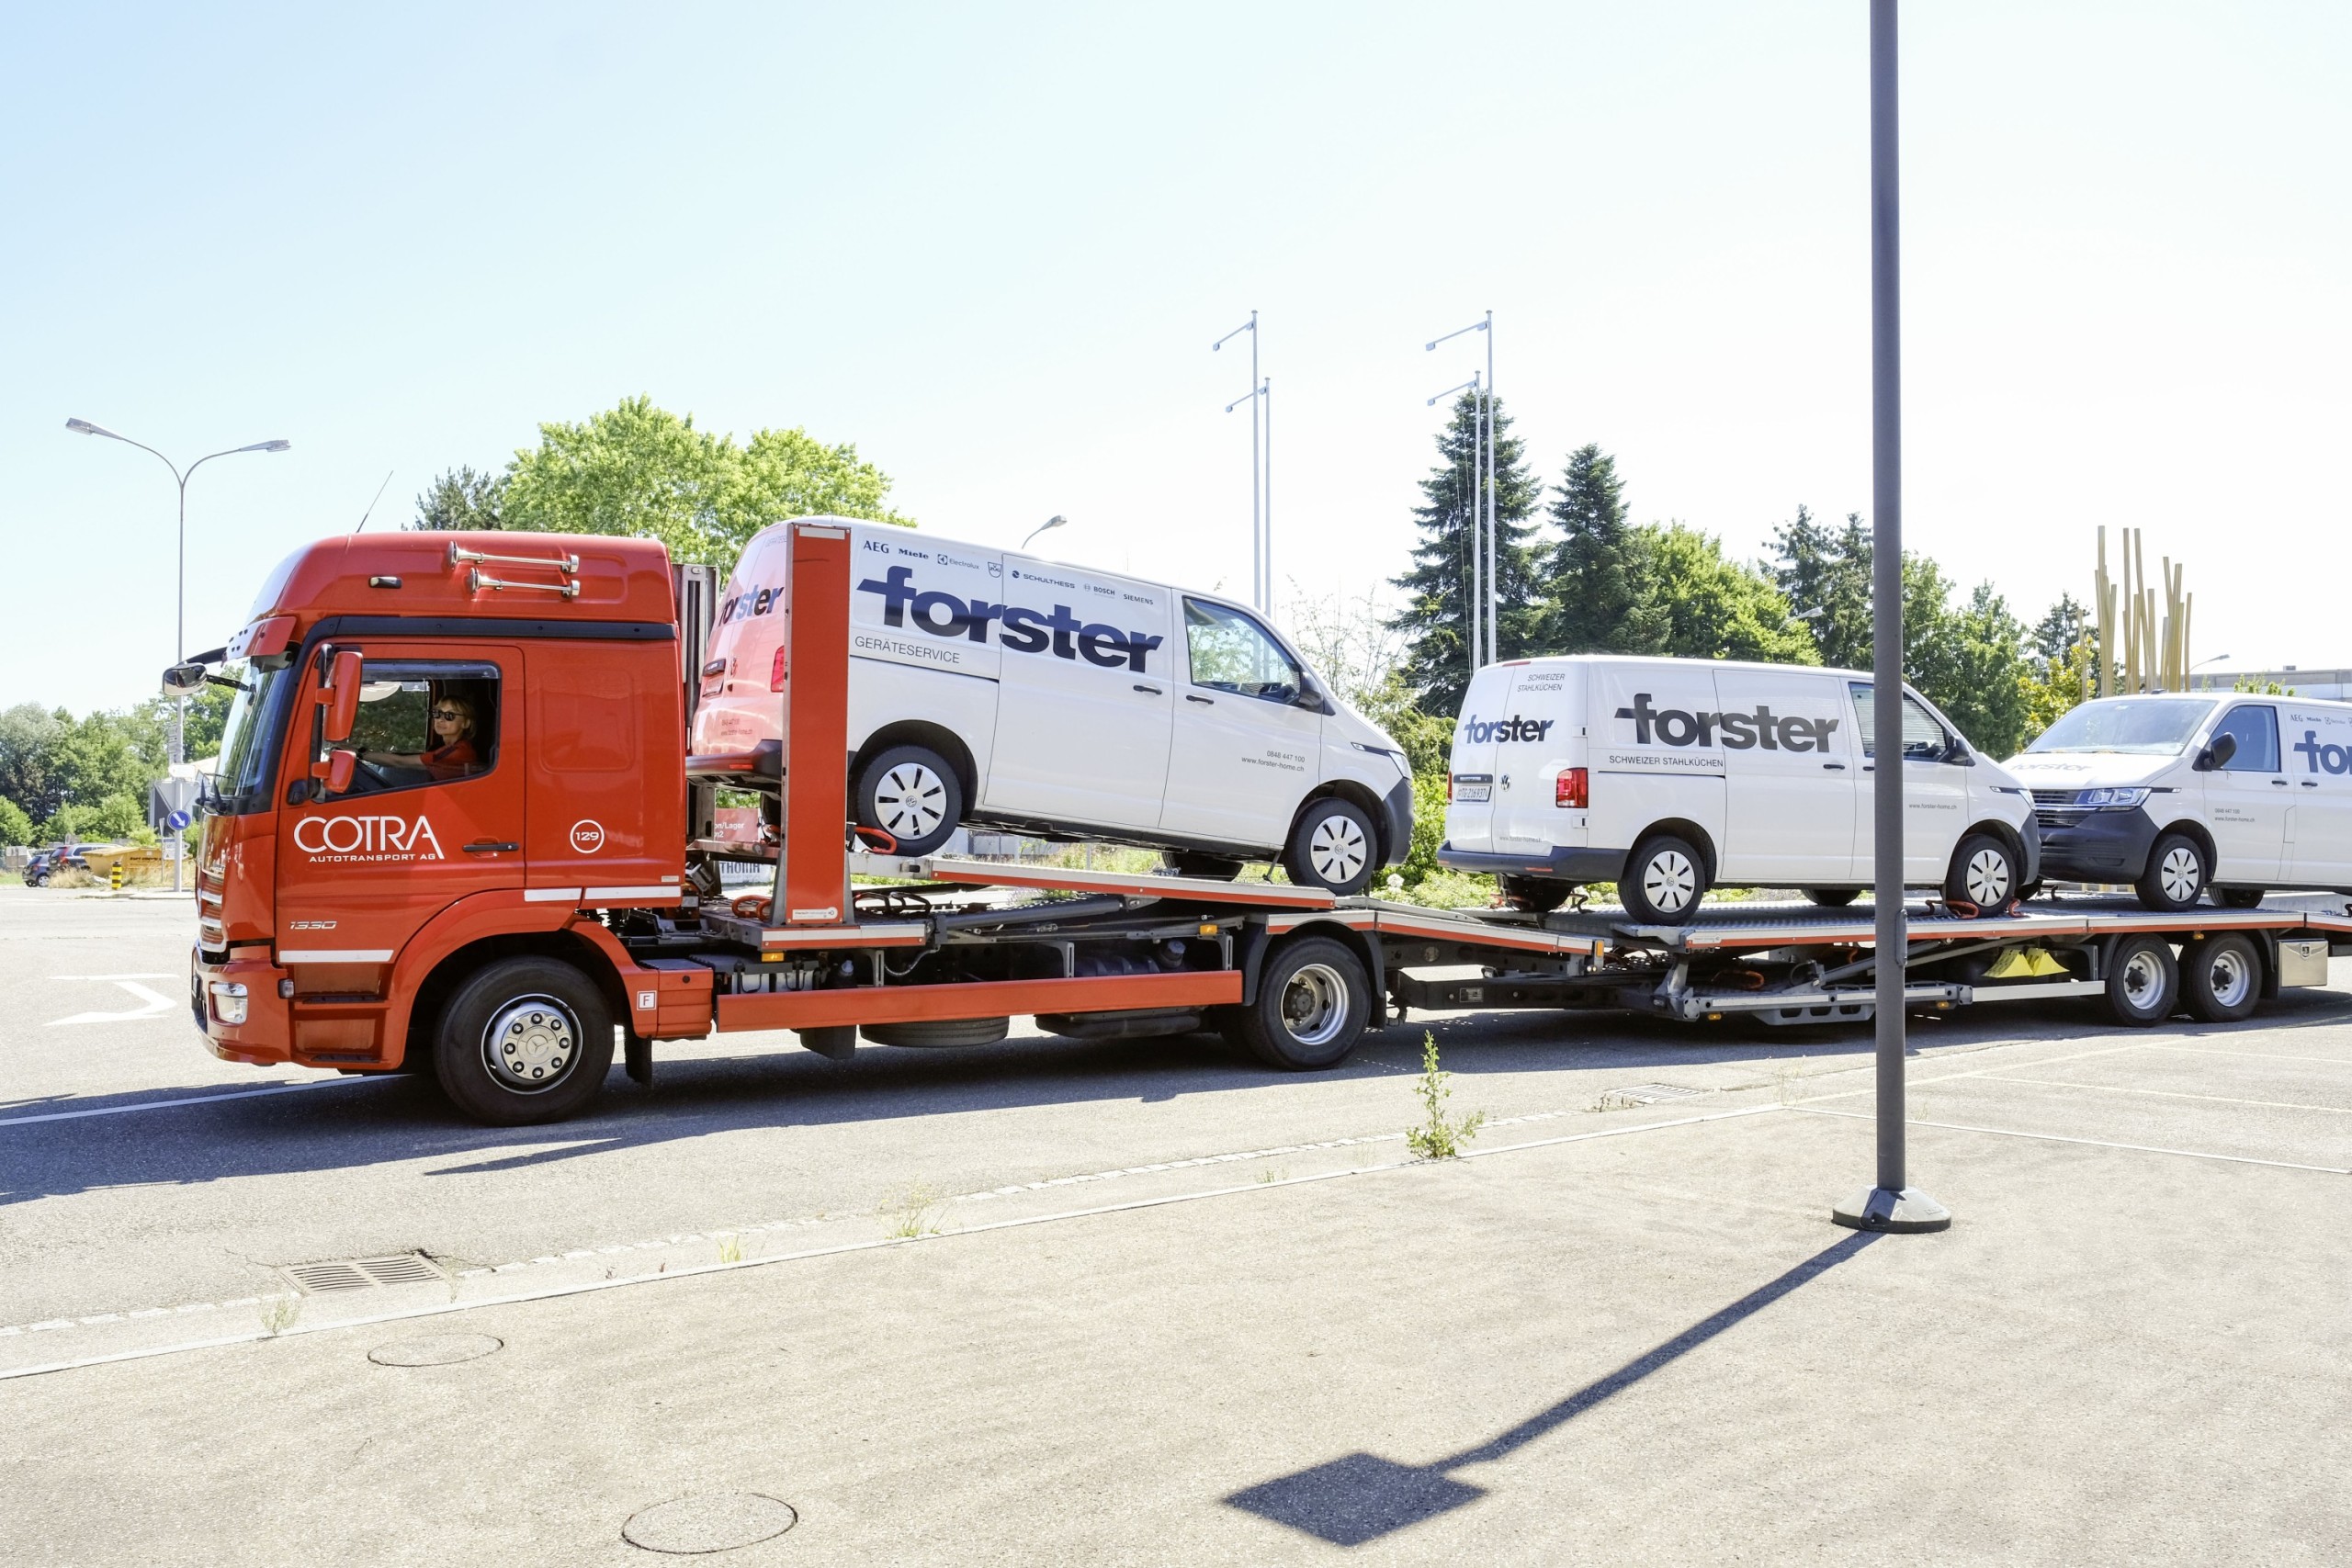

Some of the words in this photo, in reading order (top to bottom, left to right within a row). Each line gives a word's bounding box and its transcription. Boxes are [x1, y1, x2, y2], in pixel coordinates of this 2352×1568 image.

[863, 540, 889, 554] AEG
[899, 547, 929, 559] Miele
[949, 558, 979, 570] Electrolux
[1023, 573, 1075, 589] SCHULTHESS
[1093, 586, 1115, 595] BOSCH
[1123, 593, 1154, 605] SIEMENS
[856, 565, 1164, 673] forster
[854, 636, 960, 663] GERÄTESERVICE
[1527, 673, 1566, 682] SCHWEIZER
[1517, 682, 1563, 692] STAHLKÜCHEN
[1614, 693, 1839, 752] forster
[1464, 714, 1555, 744] forster
[1266, 750, 1281, 759] 0848
[1283, 752, 1294, 761] 447
[1295, 755, 1306, 763] 100
[2293, 730, 2352, 775] fo
[1241, 756, 1305, 772] www.forster-home.ch
[1609, 755, 1661, 765] SCHWEIZER
[1662, 756, 1724, 767] STAHLKÜCHEN
[293, 815, 445, 860] COTRA
[575, 831, 600, 841] 129
[309, 853, 415, 863] AUTOTRANSPORT
[289, 920, 338, 930] 1330
[643, 995, 650, 1006] F
